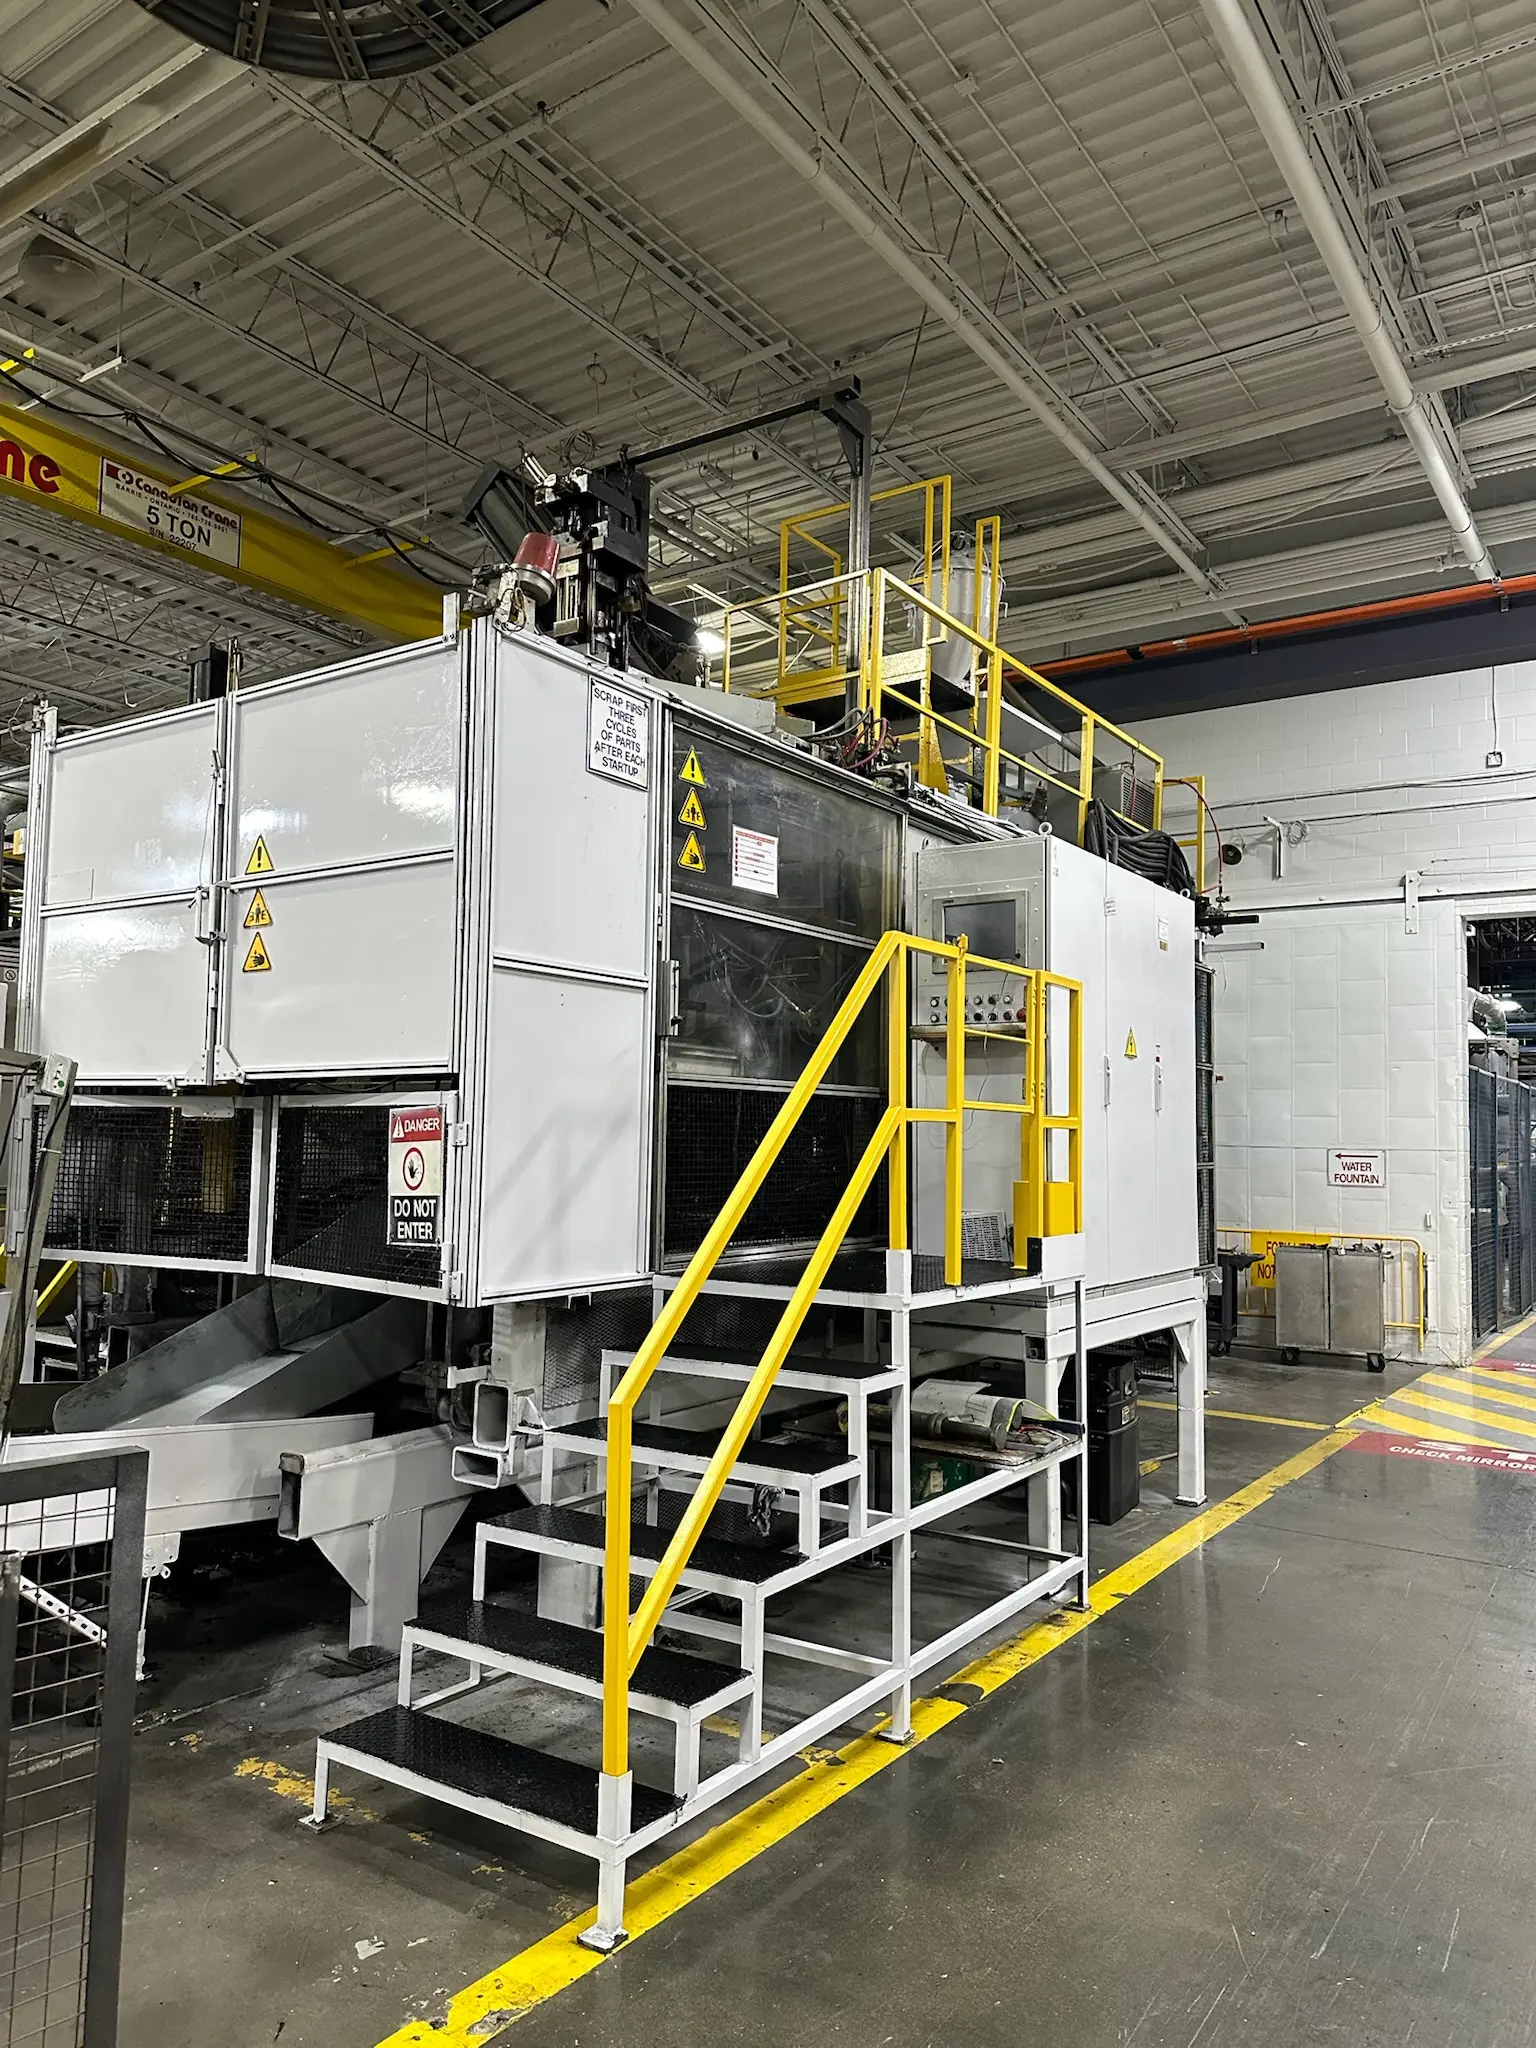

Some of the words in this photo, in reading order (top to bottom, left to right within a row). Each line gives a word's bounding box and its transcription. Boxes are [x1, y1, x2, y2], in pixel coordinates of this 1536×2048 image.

[116, 483, 142, 499] BARRIE
[150, 497, 180, 513] ONTARIO
[146, 505, 160, 525] 5
[166, 512, 211, 547] TON
[201, 505, 238, 529] Crane
[149, 526, 165, 539] S/N
[169, 534, 197, 552] 22207
[594, 687, 624, 706] SCRAP
[625, 700, 647, 718] FIRST
[608, 705, 635, 726] THREE
[605, 718, 637, 739] CYCLES
[601, 729, 613, 741] OF
[616, 735, 641, 753] PARTS
[594, 741, 623, 759] AFTER
[625, 751, 646, 768] EACH
[602, 756, 639, 777] STARTUP
[404, 1117, 440, 1133] DANGER
[1341, 1161, 1372, 1172] WATER
[1334, 1173, 1379, 1184] FOUNTAIN
[394, 1199, 411, 1217] DO
[413, 1199, 437, 1217] NOT
[397, 1221, 433, 1240] ENTER
[1389, 1445, 1453, 1460] CHECK
